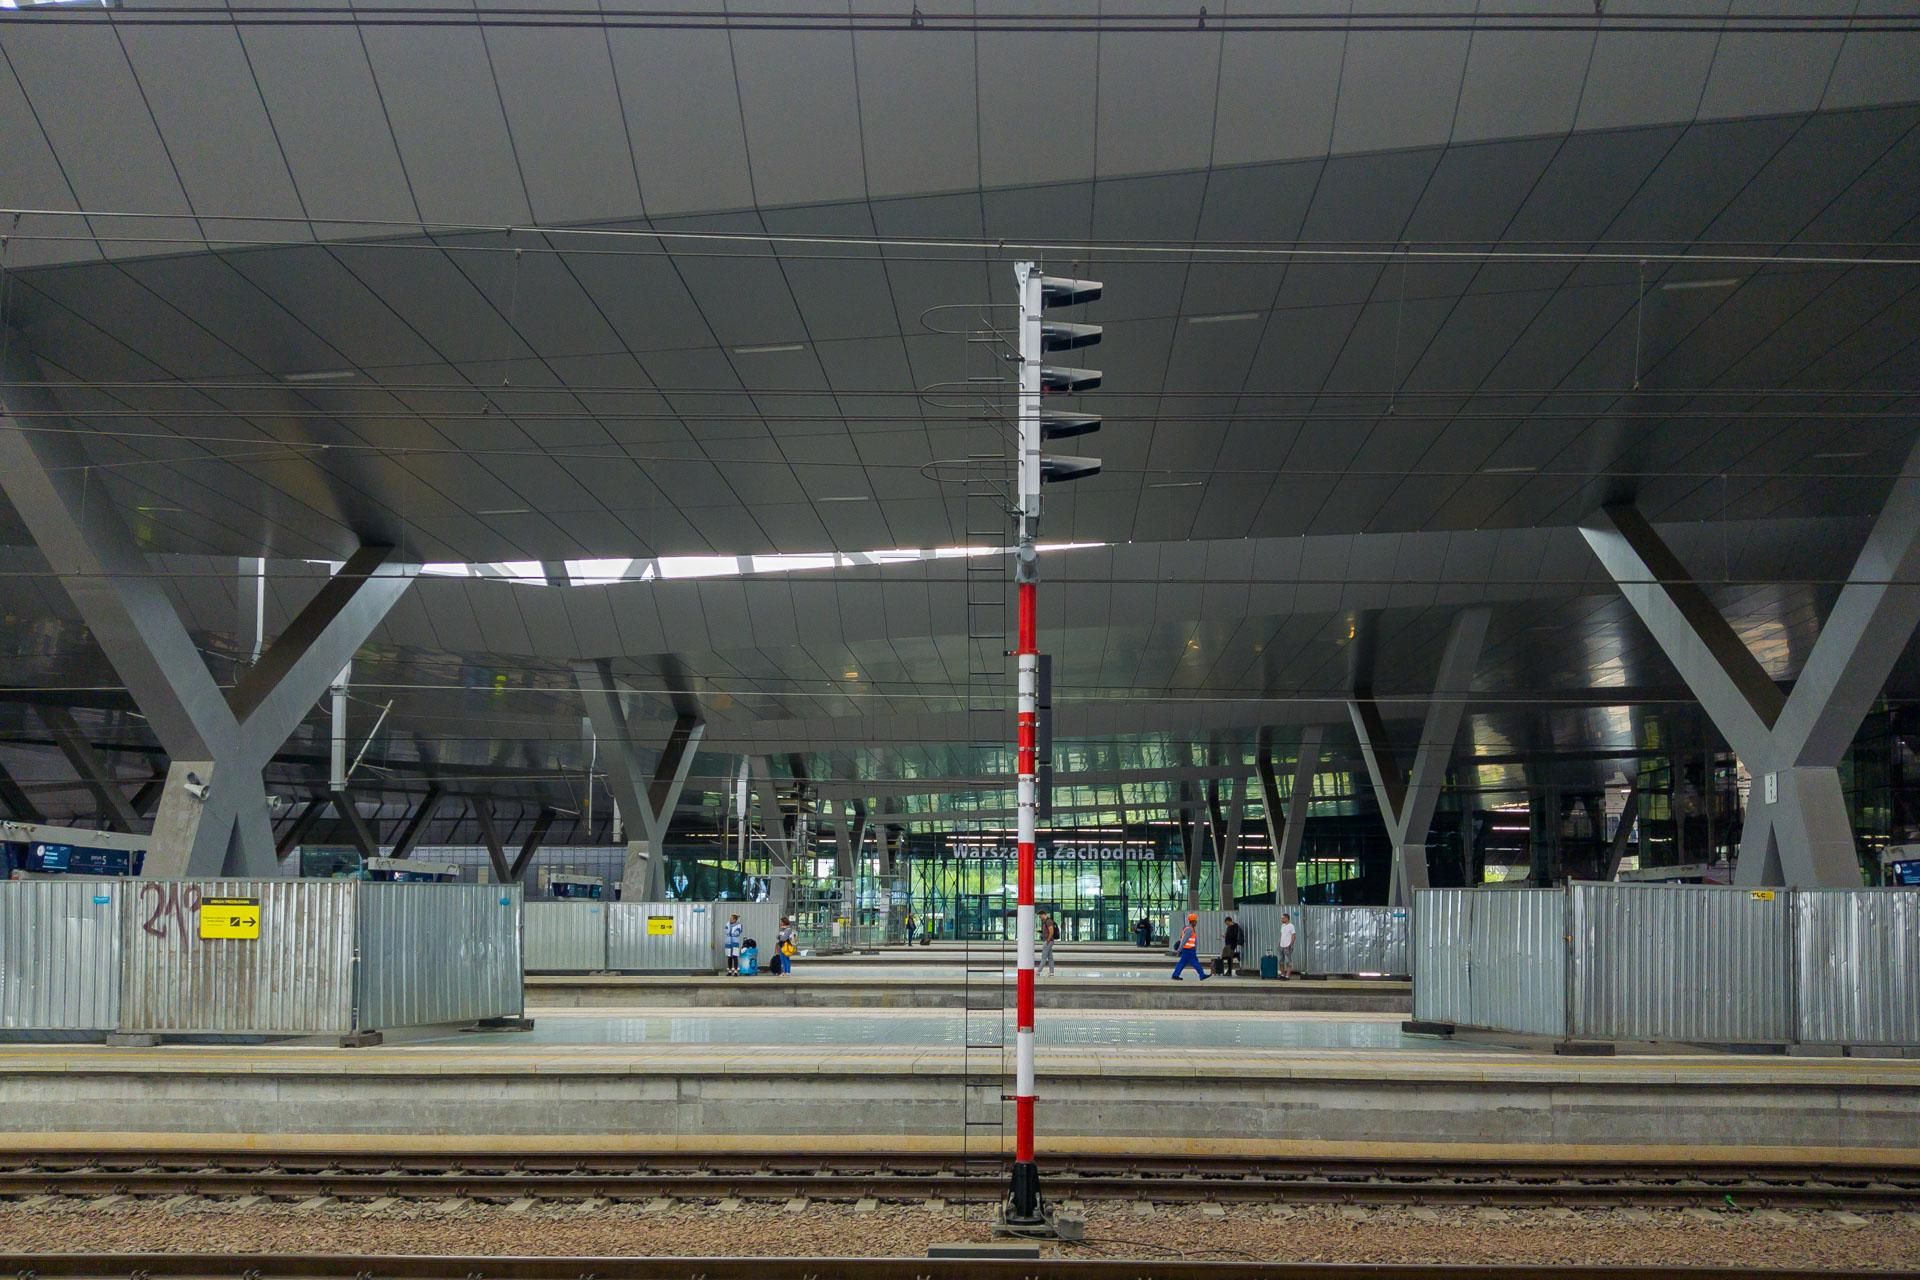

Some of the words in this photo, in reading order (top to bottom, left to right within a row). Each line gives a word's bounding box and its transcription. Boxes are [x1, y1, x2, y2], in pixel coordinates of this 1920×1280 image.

[953, 843, 1047, 859] Warszaa
[1053, 843, 1155, 860] Zachodnia
[102, 855, 107, 865] 5
